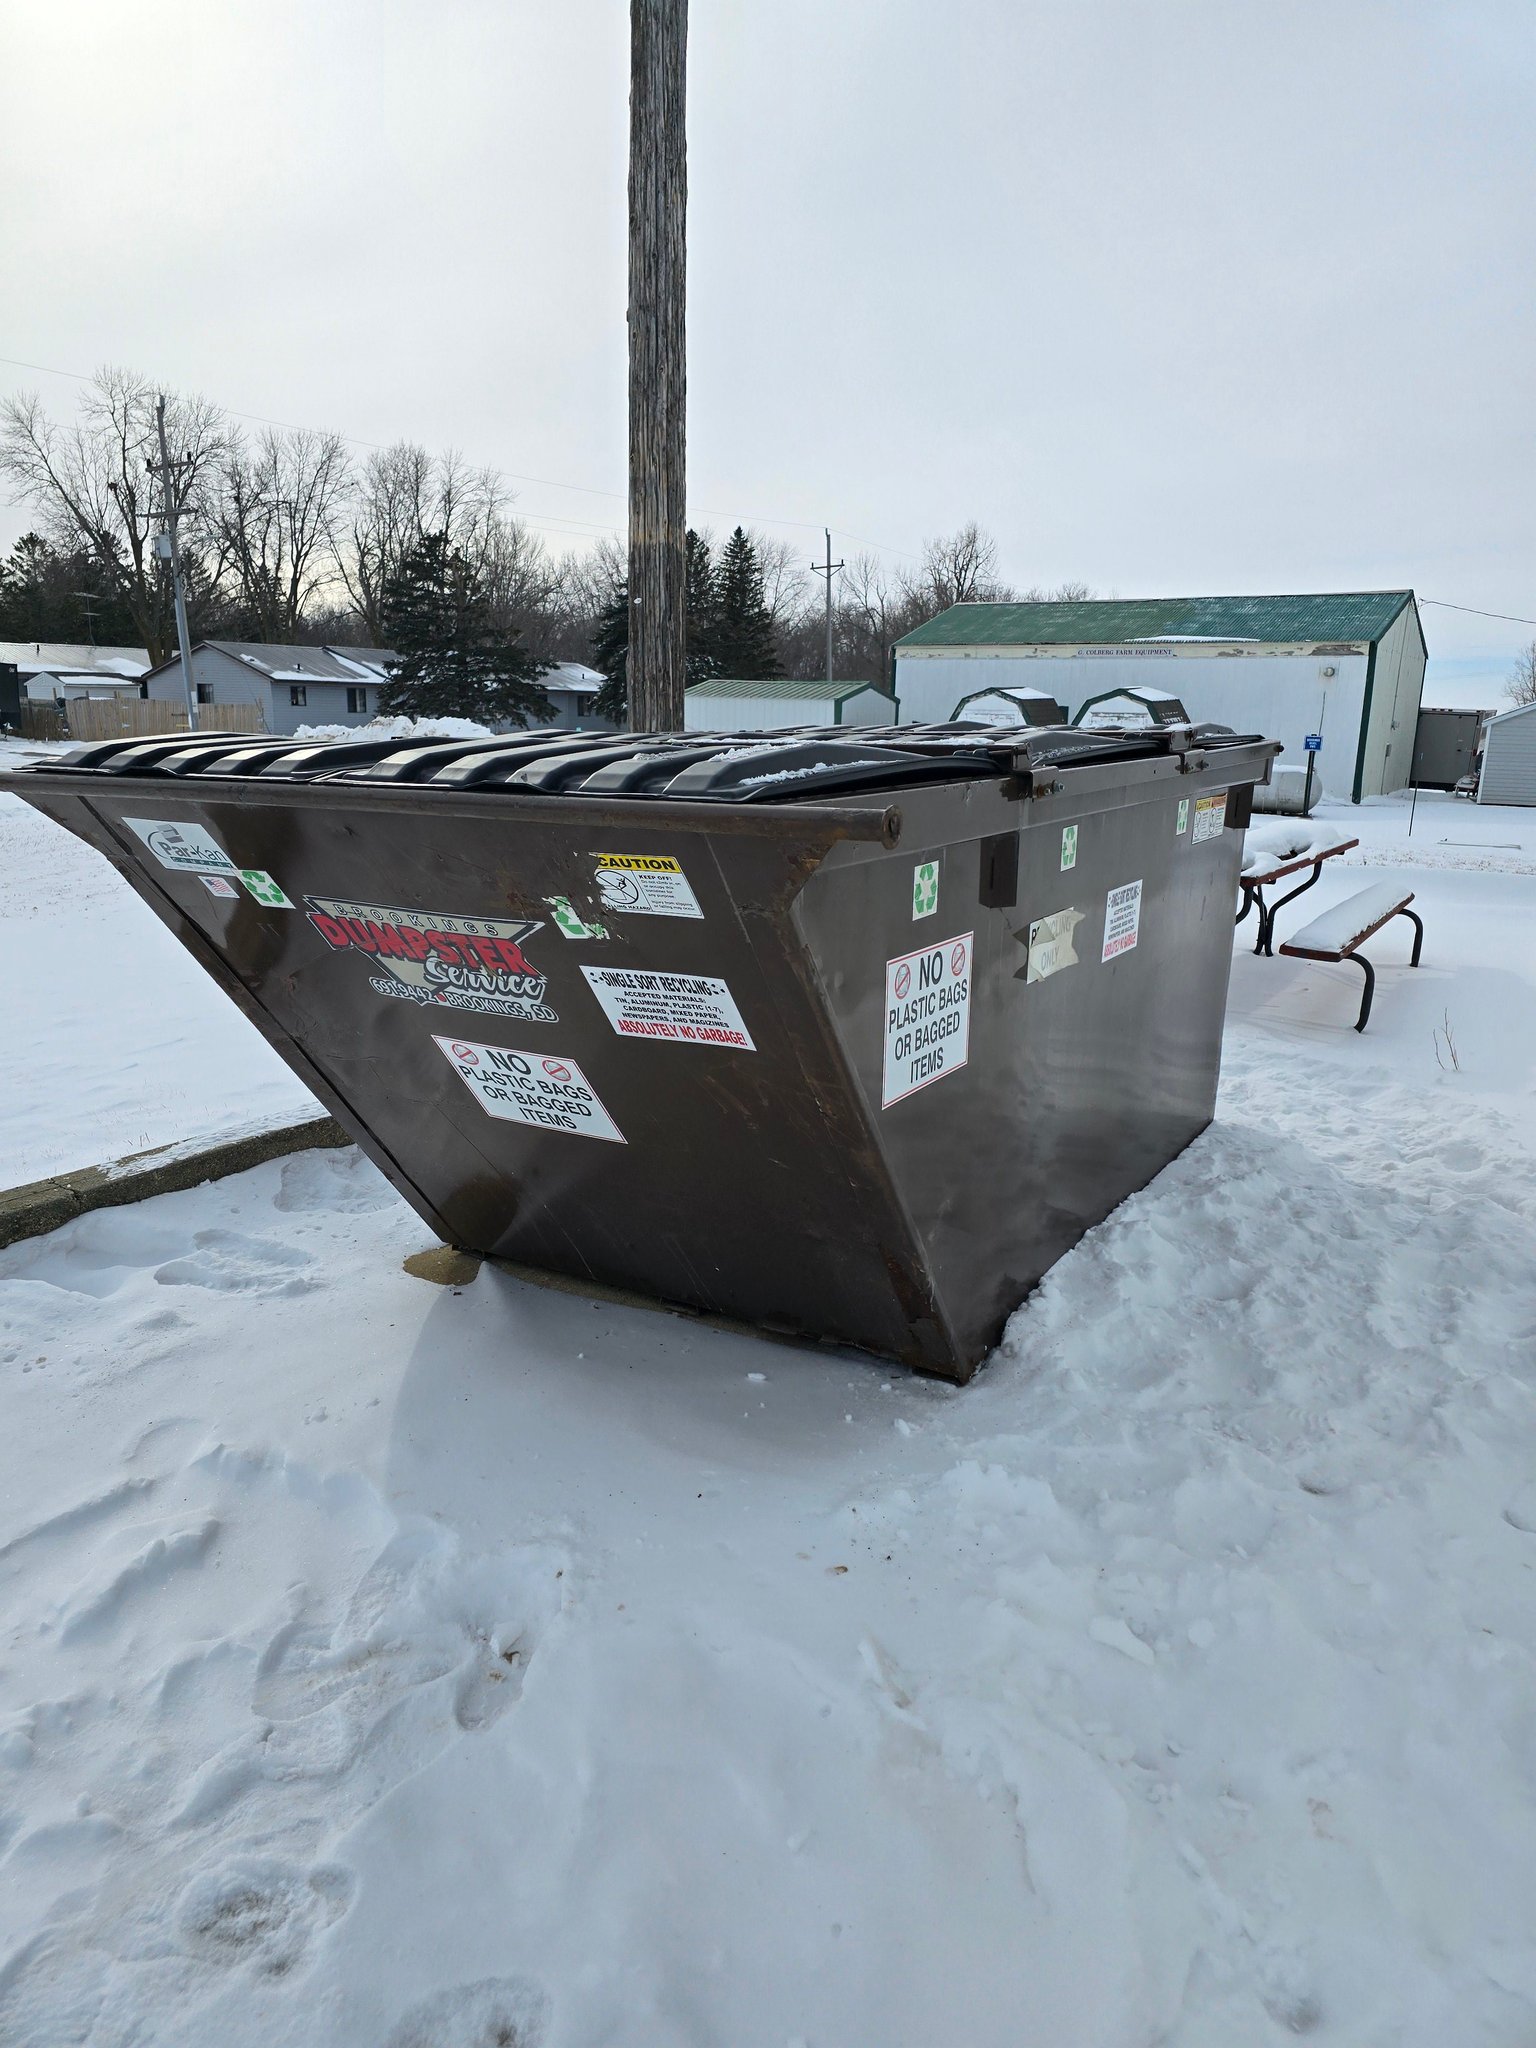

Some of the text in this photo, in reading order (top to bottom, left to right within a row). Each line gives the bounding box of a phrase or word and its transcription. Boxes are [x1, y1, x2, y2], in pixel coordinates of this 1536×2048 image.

[157, 841, 228, 861] Par-Kan
[600, 857, 676, 871] CAUTION
[333, 903, 499, 935] BROOKINGS
[312, 914, 538, 975] DUMPSTER
[1041, 945, 1060, 971] ONLY
[425, 957, 541, 994] Service
[600, 971, 712, 996] SINGLE SORT RECYCLING
[919, 950, 943, 991] NO
[445, 993, 531, 1020] BROOKINGS,
[535, 1005, 556, 1020] SD
[624, 991, 661, 999] ACCEPTED
[631, 999, 672, 1008] ALUMINUM,
[889, 978, 968, 1034] PLASTIC BAGS
[622, 1012, 672, 1022] NEWSPAPERS,
[623, 1005, 721, 1020] CARDBOARD, MIXED PAPER,
[617, 1019, 748, 1046] ABSOLUTELY NO GARBAGE!
[895, 1011, 960, 1061] OR BAGGED
[485, 1049, 532, 1075] NO
[910, 1046, 944, 1083] ITEMS
[458, 1065, 593, 1101] PLASTIC BAGS
[482, 1085, 592, 1117] OR BAGGED
[519, 1107, 577, 1129] ITEMS
